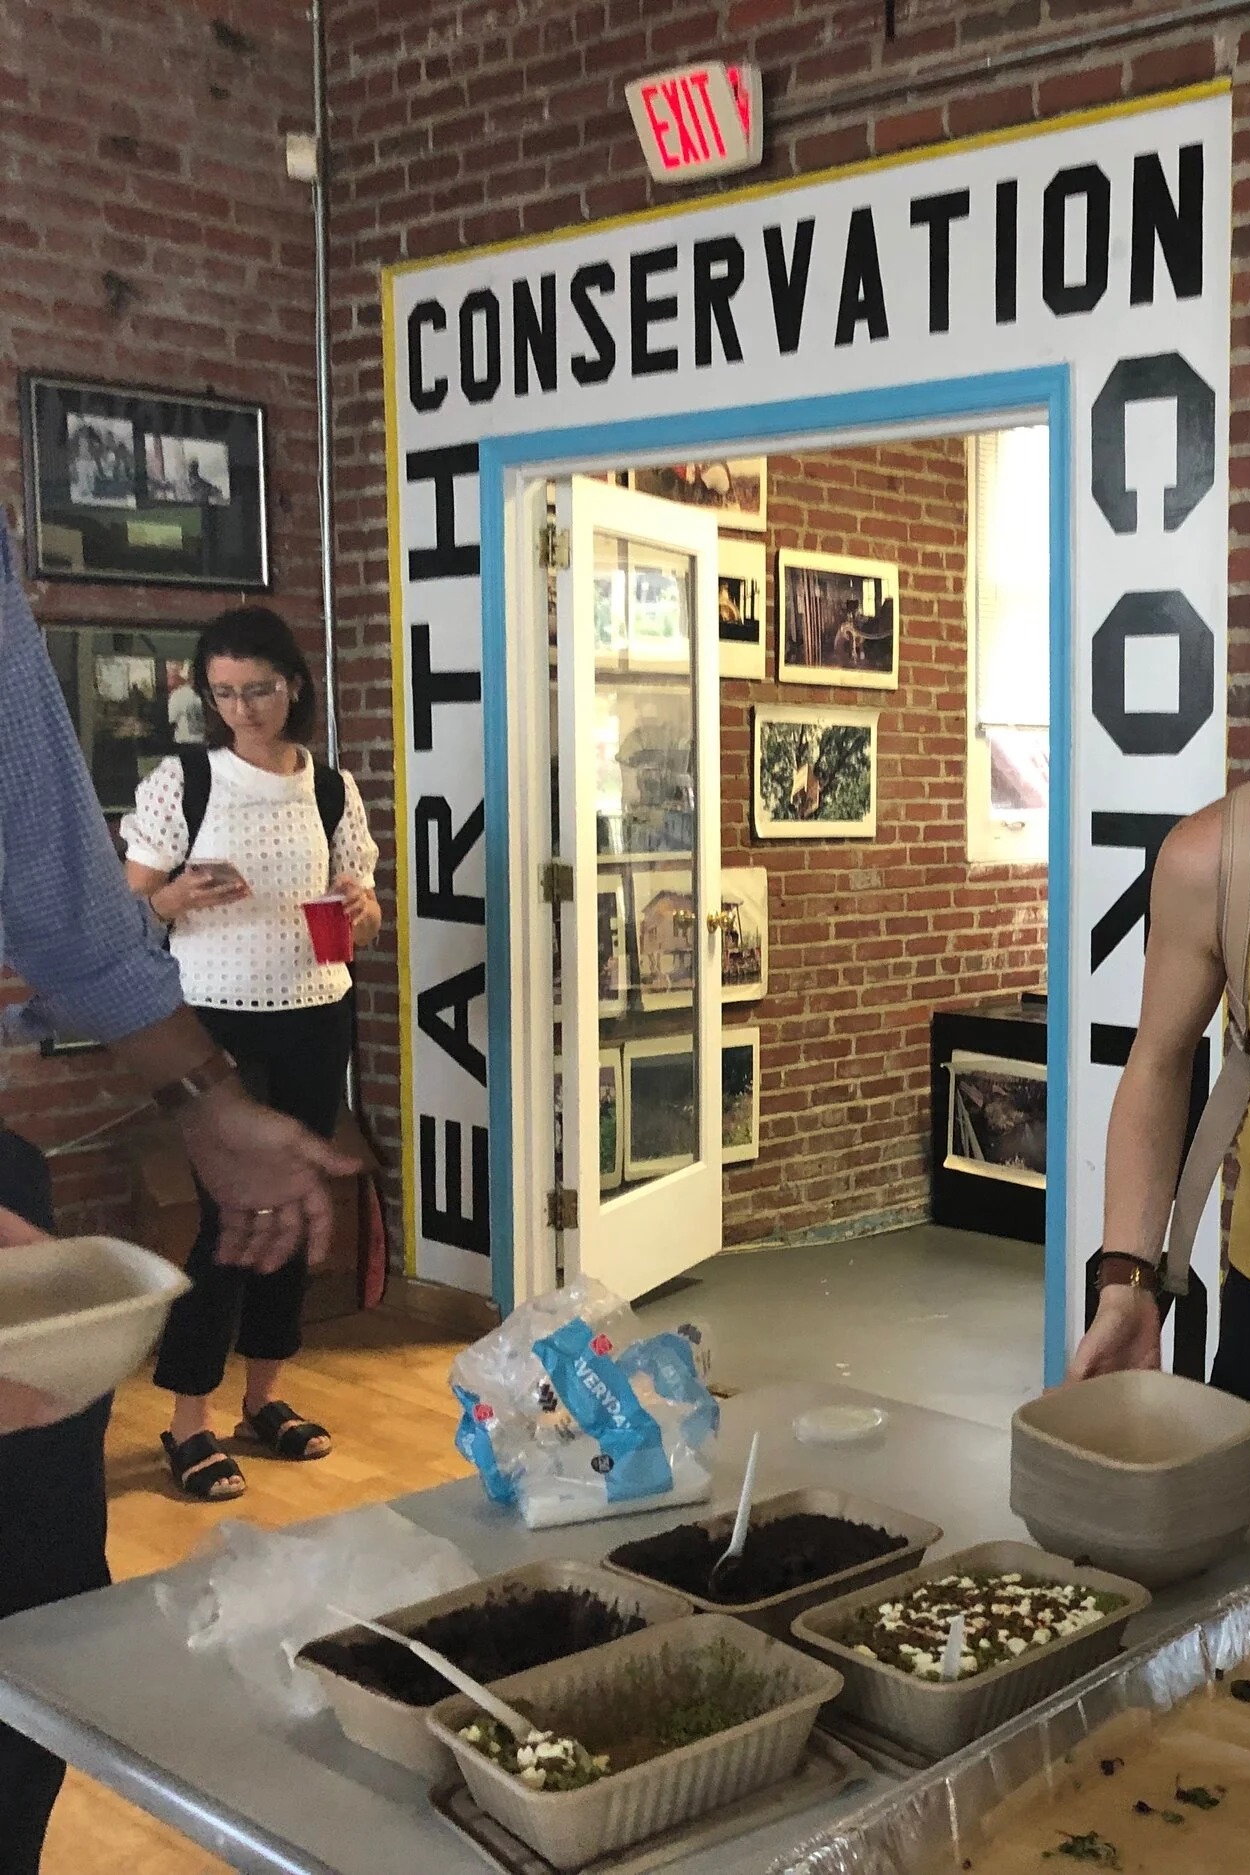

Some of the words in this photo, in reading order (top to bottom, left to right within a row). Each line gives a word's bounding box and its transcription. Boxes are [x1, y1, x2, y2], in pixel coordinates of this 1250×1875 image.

[640, 70, 727, 171] EXIT
[407, 140, 1204, 413] CONSERVATION
[405, 440, 491, 1258] EARTH
